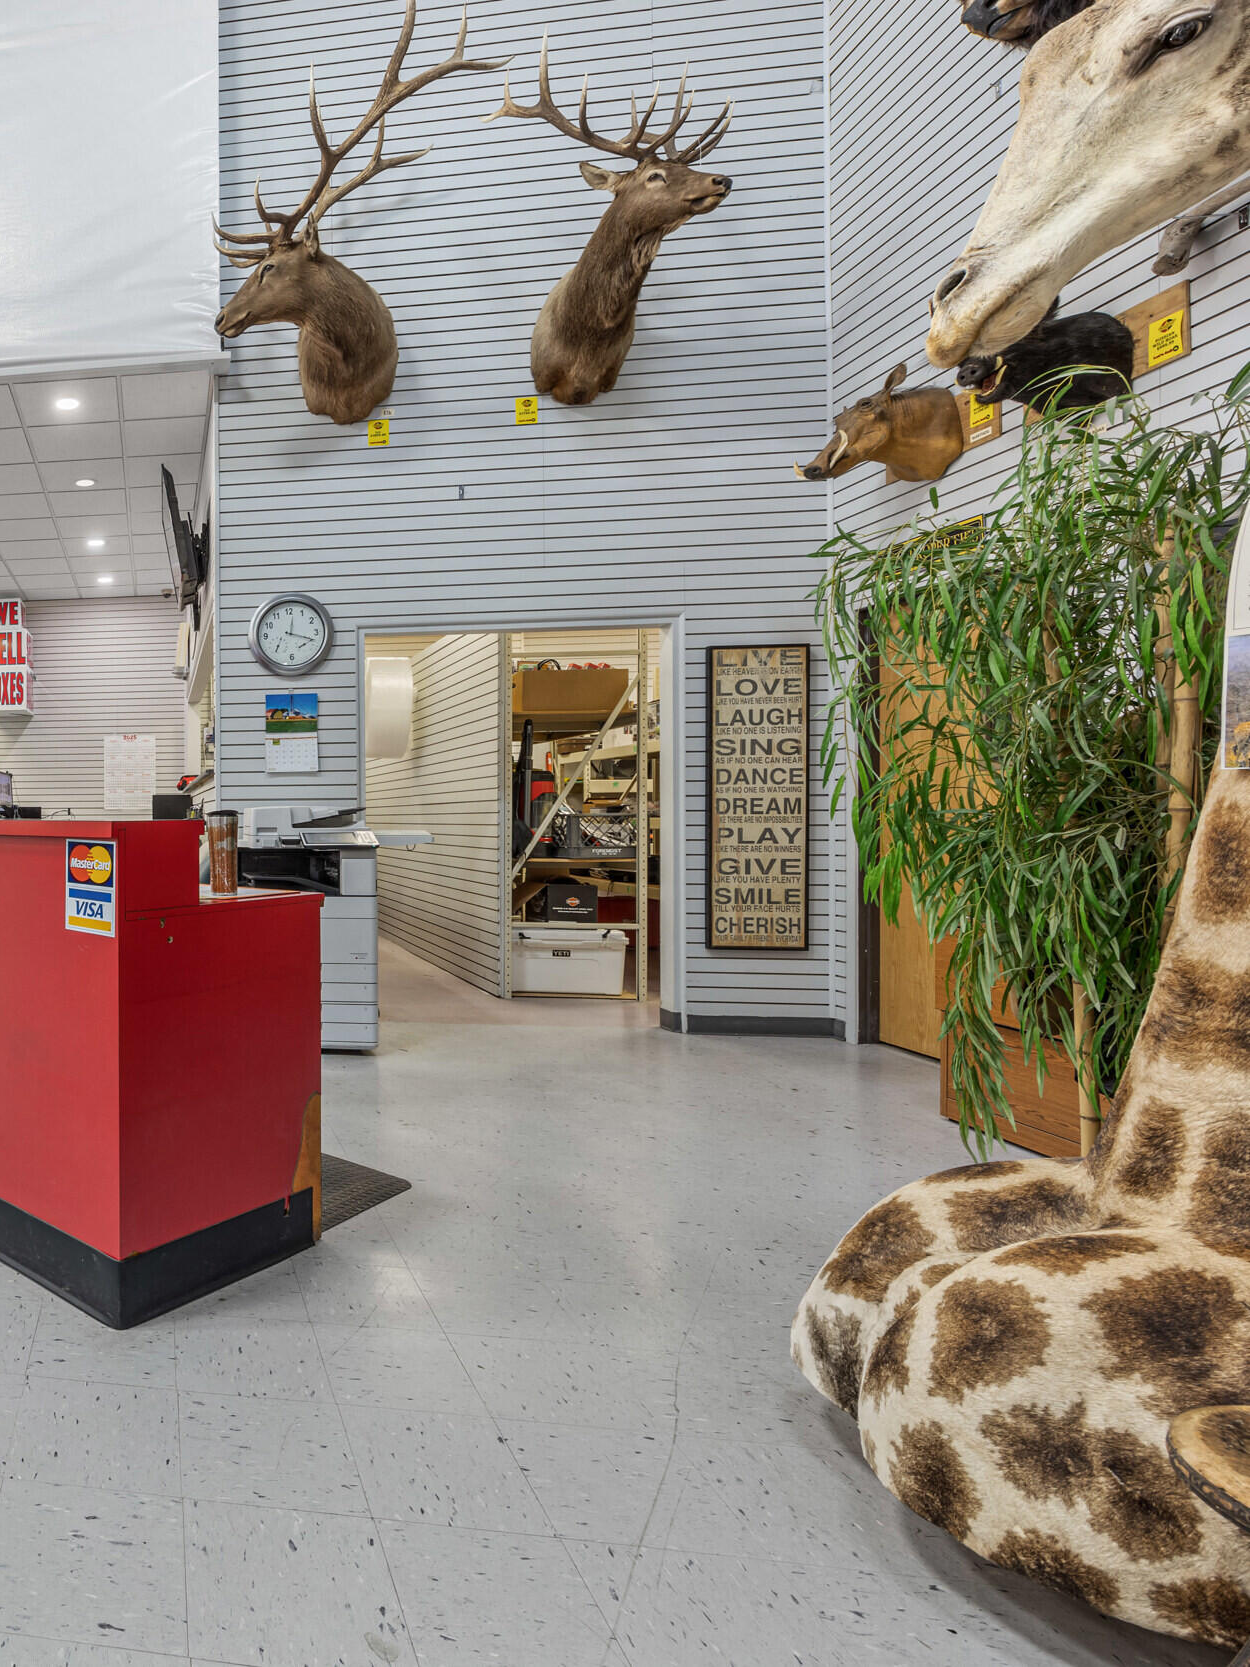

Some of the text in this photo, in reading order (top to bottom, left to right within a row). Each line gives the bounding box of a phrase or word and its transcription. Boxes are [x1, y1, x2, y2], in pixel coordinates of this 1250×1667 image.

[717, 649, 803, 667] LIVE
[733, 667, 759, 676] HEAVE
[716, 678, 802, 696] LOVE
[716, 698, 727, 706] LIKE
[740, 697, 754, 705] HAVE
[774, 696, 787, 704] BEEN
[788, 696, 803, 704] HURT
[715, 708, 803, 726] LAUGH
[733, 727, 742, 735] NO
[744, 727, 758, 735] ONE
[767, 726, 802, 734] LISTENING
[715, 738, 802, 756] SING
[782, 756, 803, 764] HEAR
[716, 768, 804, 785] DANCE
[716, 797, 802, 815] DREAM
[717, 828, 802, 844] PLAY
[730, 845, 749, 853] THERE
[750, 845, 763, 853] ARE
[774, 845, 802, 853] WINNERS
[70, 857, 110, 871] MasterCard
[718, 858, 802, 875] GIVE
[714, 876, 730, 884] LIKE
[750, 876, 770, 884] HAVE
[772, 876, 801, 884] PLENTY
[715, 888, 801, 904] SMILE
[76, 900, 104, 919] VISA
[715, 916, 801, 934] CHERISH
